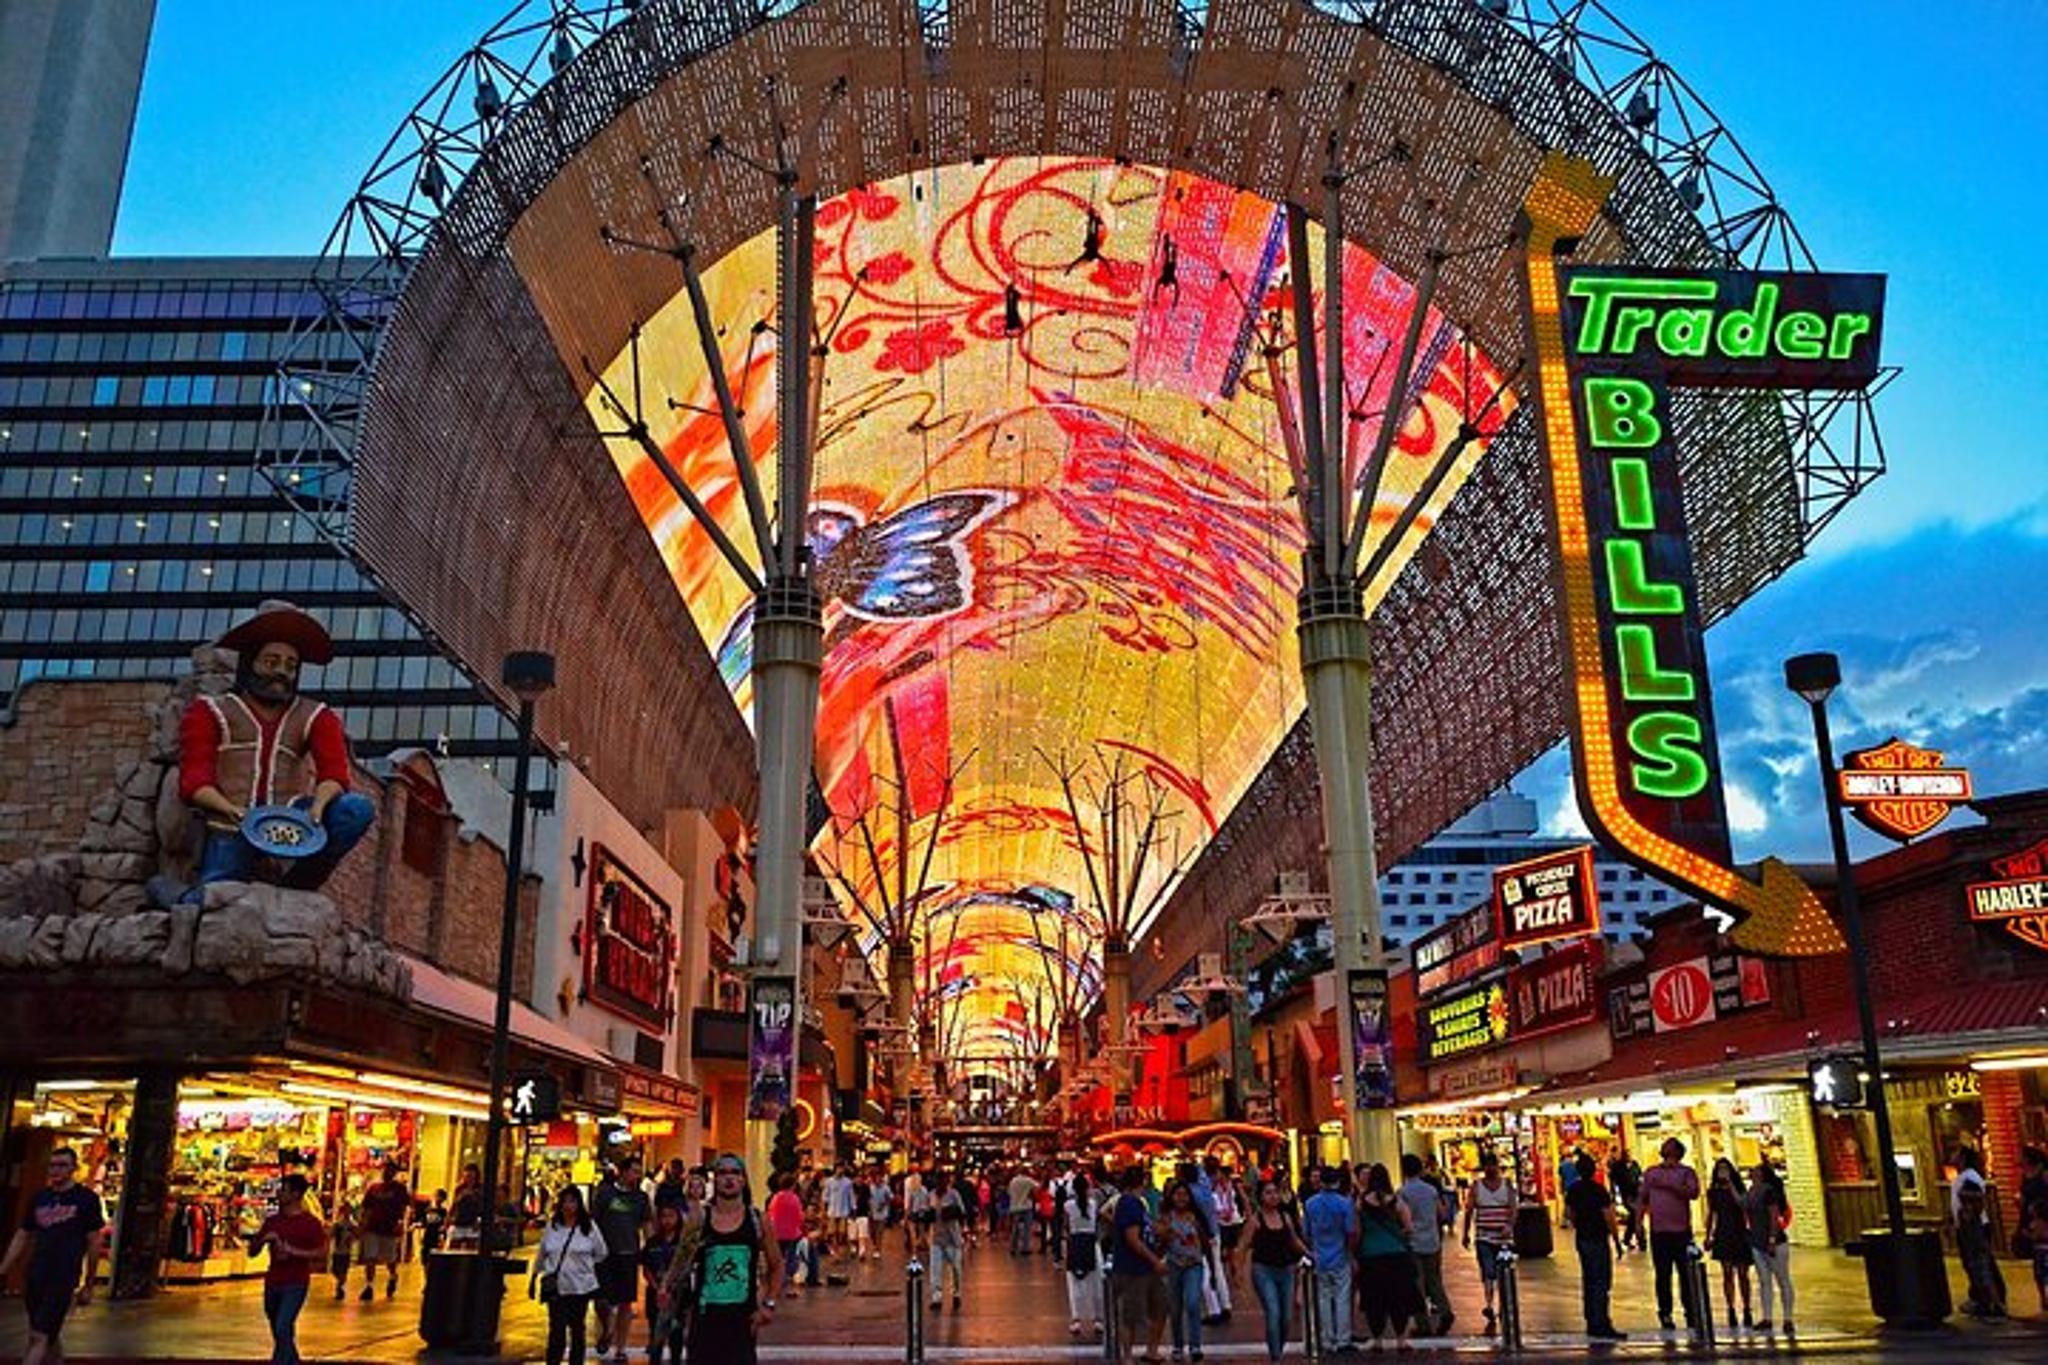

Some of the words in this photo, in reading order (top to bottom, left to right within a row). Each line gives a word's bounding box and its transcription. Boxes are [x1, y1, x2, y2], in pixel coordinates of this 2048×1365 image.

[1568, 277, 1871, 360] Trader
[1583, 377, 1708, 797] BILLS
[1513, 894, 1573, 931] PIZZA
[1538, 962, 1586, 1014] PIZZA
